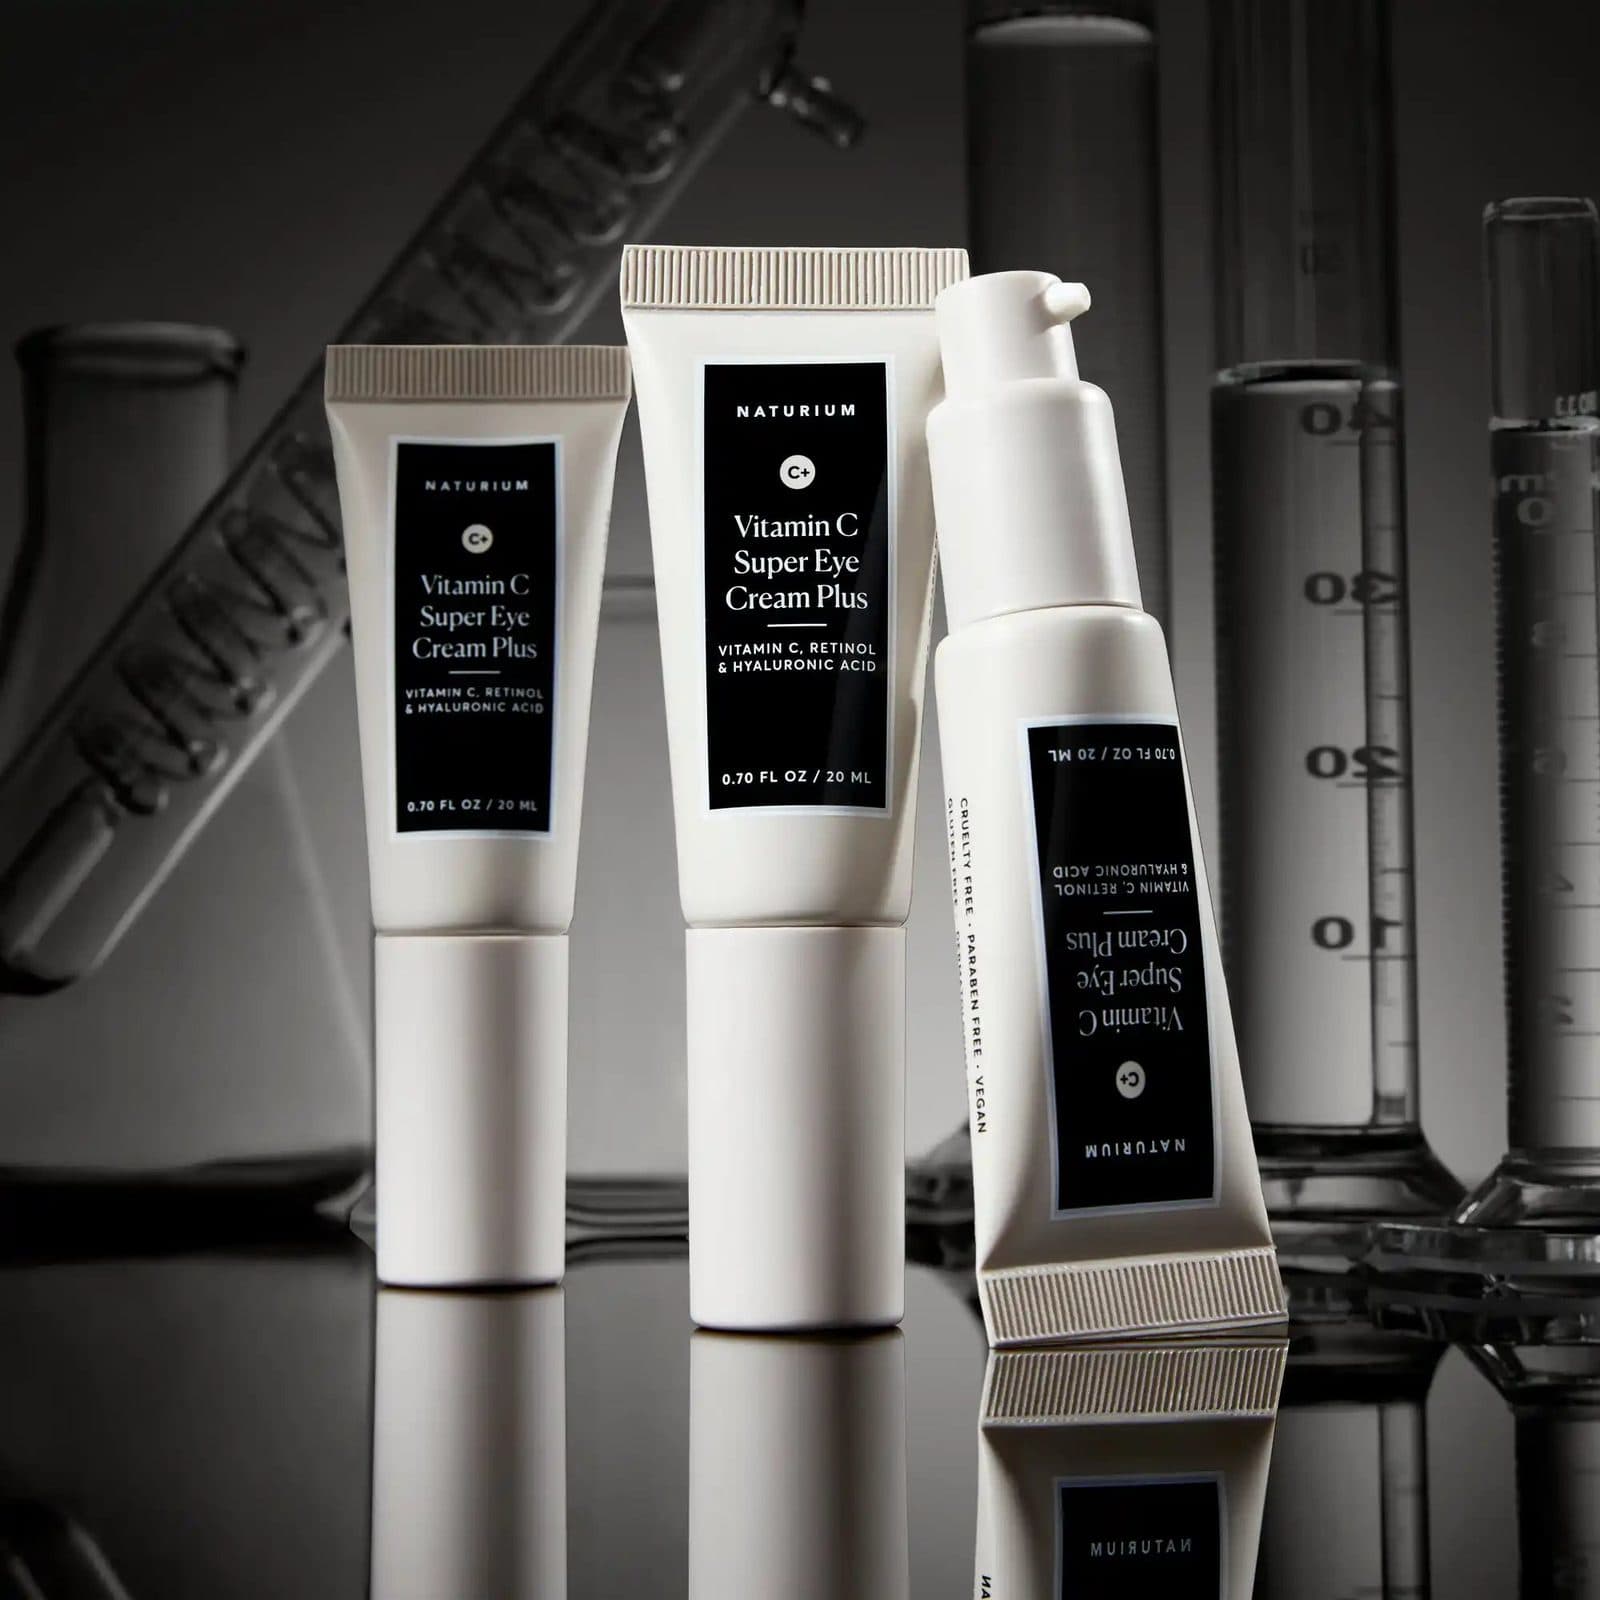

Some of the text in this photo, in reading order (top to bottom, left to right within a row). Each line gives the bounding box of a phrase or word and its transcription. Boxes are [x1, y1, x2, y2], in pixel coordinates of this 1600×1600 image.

[736, 403, 855, 418] NATURIUM
[425, 479, 529, 492] NATURIUM
[733, 512, 858, 538] Vitamin C
[734, 548, 860, 580] Super Eye
[420, 574, 529, 596] Vitamin C
[725, 584, 868, 611] Cream Plus
[420, 605, 530, 632] Super Eye
[412, 636, 537, 659] Cream Plus
[718, 641, 876, 657] VITAMIN C, RETINOL
[718, 658, 876, 674] & HYALURONIC ACID
[405, 687, 462, 699] VITAMIN
[485, 686, 543, 699] RETINOL
[405, 701, 544, 715] & HYALURONIC ACID
[1047, 746, 1176, 762] 0.70 FL OZ / 20 ML
[722, 769, 872, 786] 0.70 FL OZ / 20 ML
[407, 798, 538, 813] 0.70 FL OZ / 20 ML
[1052, 863, 1188, 879] & HYALURONIC ACID
[1053, 880, 1190, 897] VITAMIN C, RETINOL
[1066, 928, 1188, 958] Cream Plus
[960, 797, 988, 1134] CRUELTY FREE PARABEN FREE VEGAN
[1077, 964, 1182, 996] Super Eye
[1079, 1006, 1184, 1036] Vitamin C
[1085, 1138, 1185, 1158] NATURIUM
